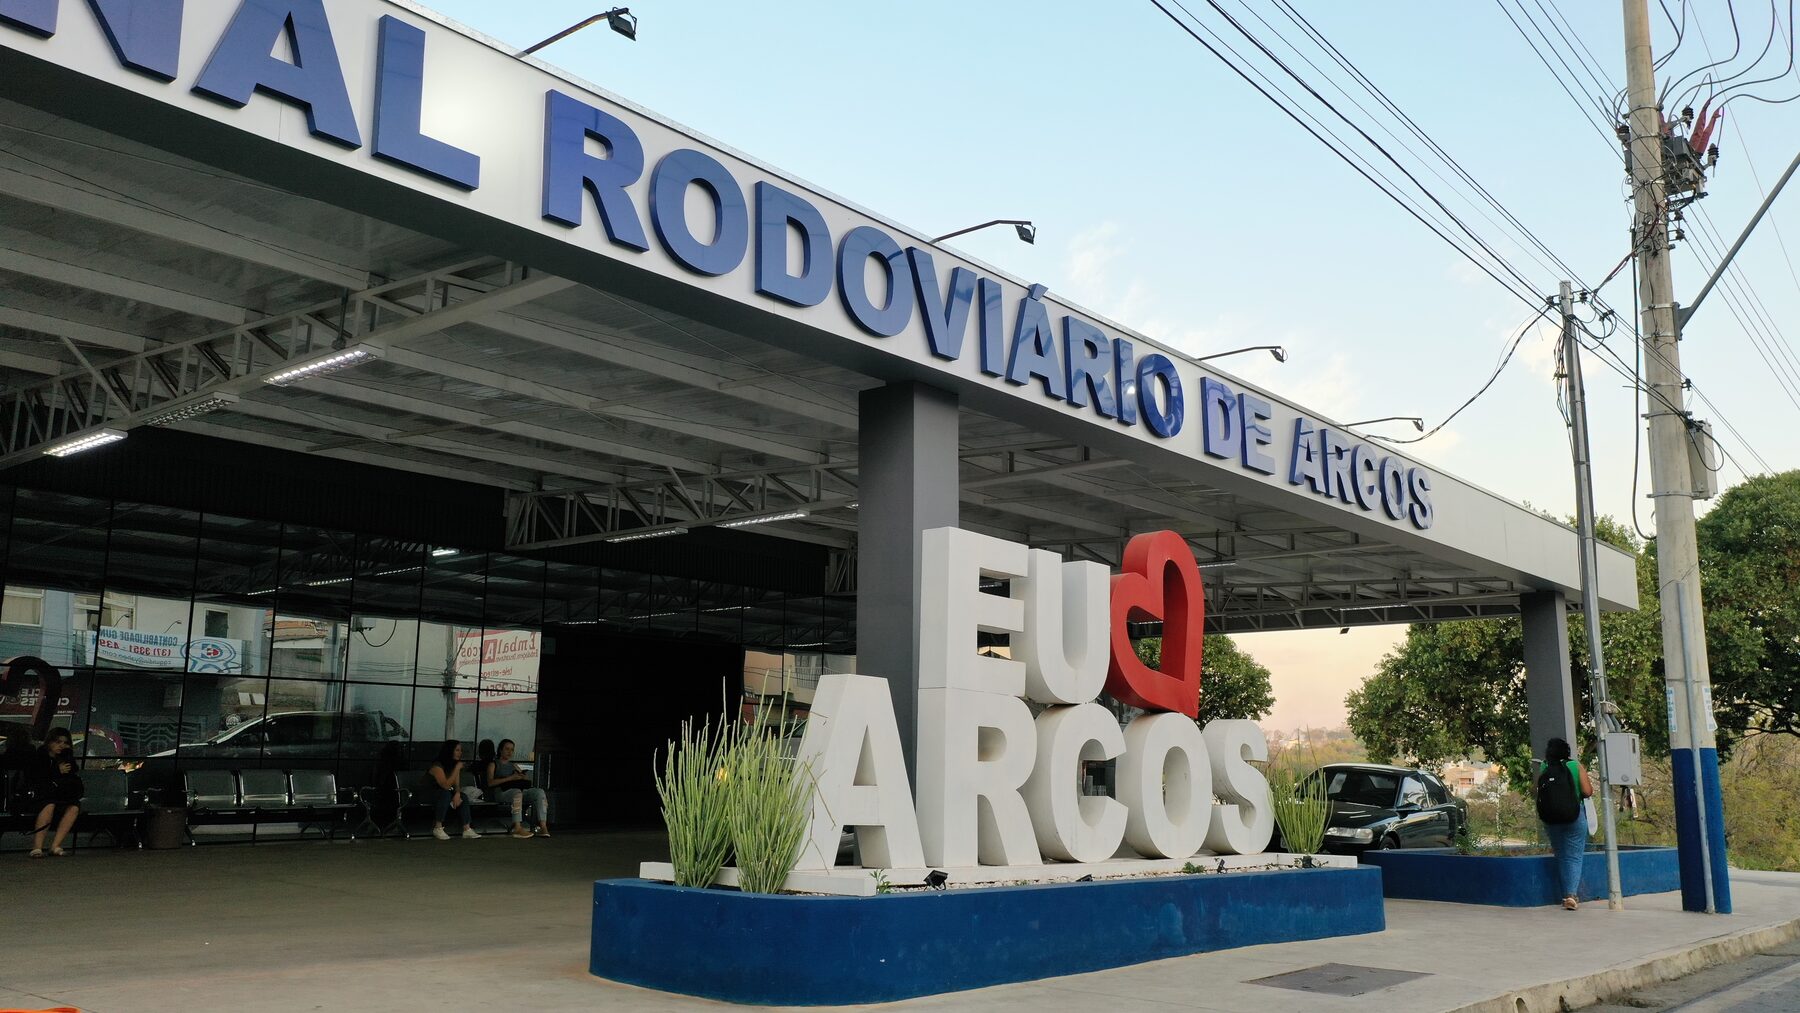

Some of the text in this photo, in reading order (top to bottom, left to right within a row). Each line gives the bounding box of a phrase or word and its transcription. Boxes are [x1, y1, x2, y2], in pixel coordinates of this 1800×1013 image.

[541, 89, 1185, 439] RODOVIÁRIO
[1200, 376, 1276, 476] DE
[1288, 417, 1434, 530] ARCOS
[919, 526, 1111, 704] EU
[795, 673, 1275, 870] ARCOS
